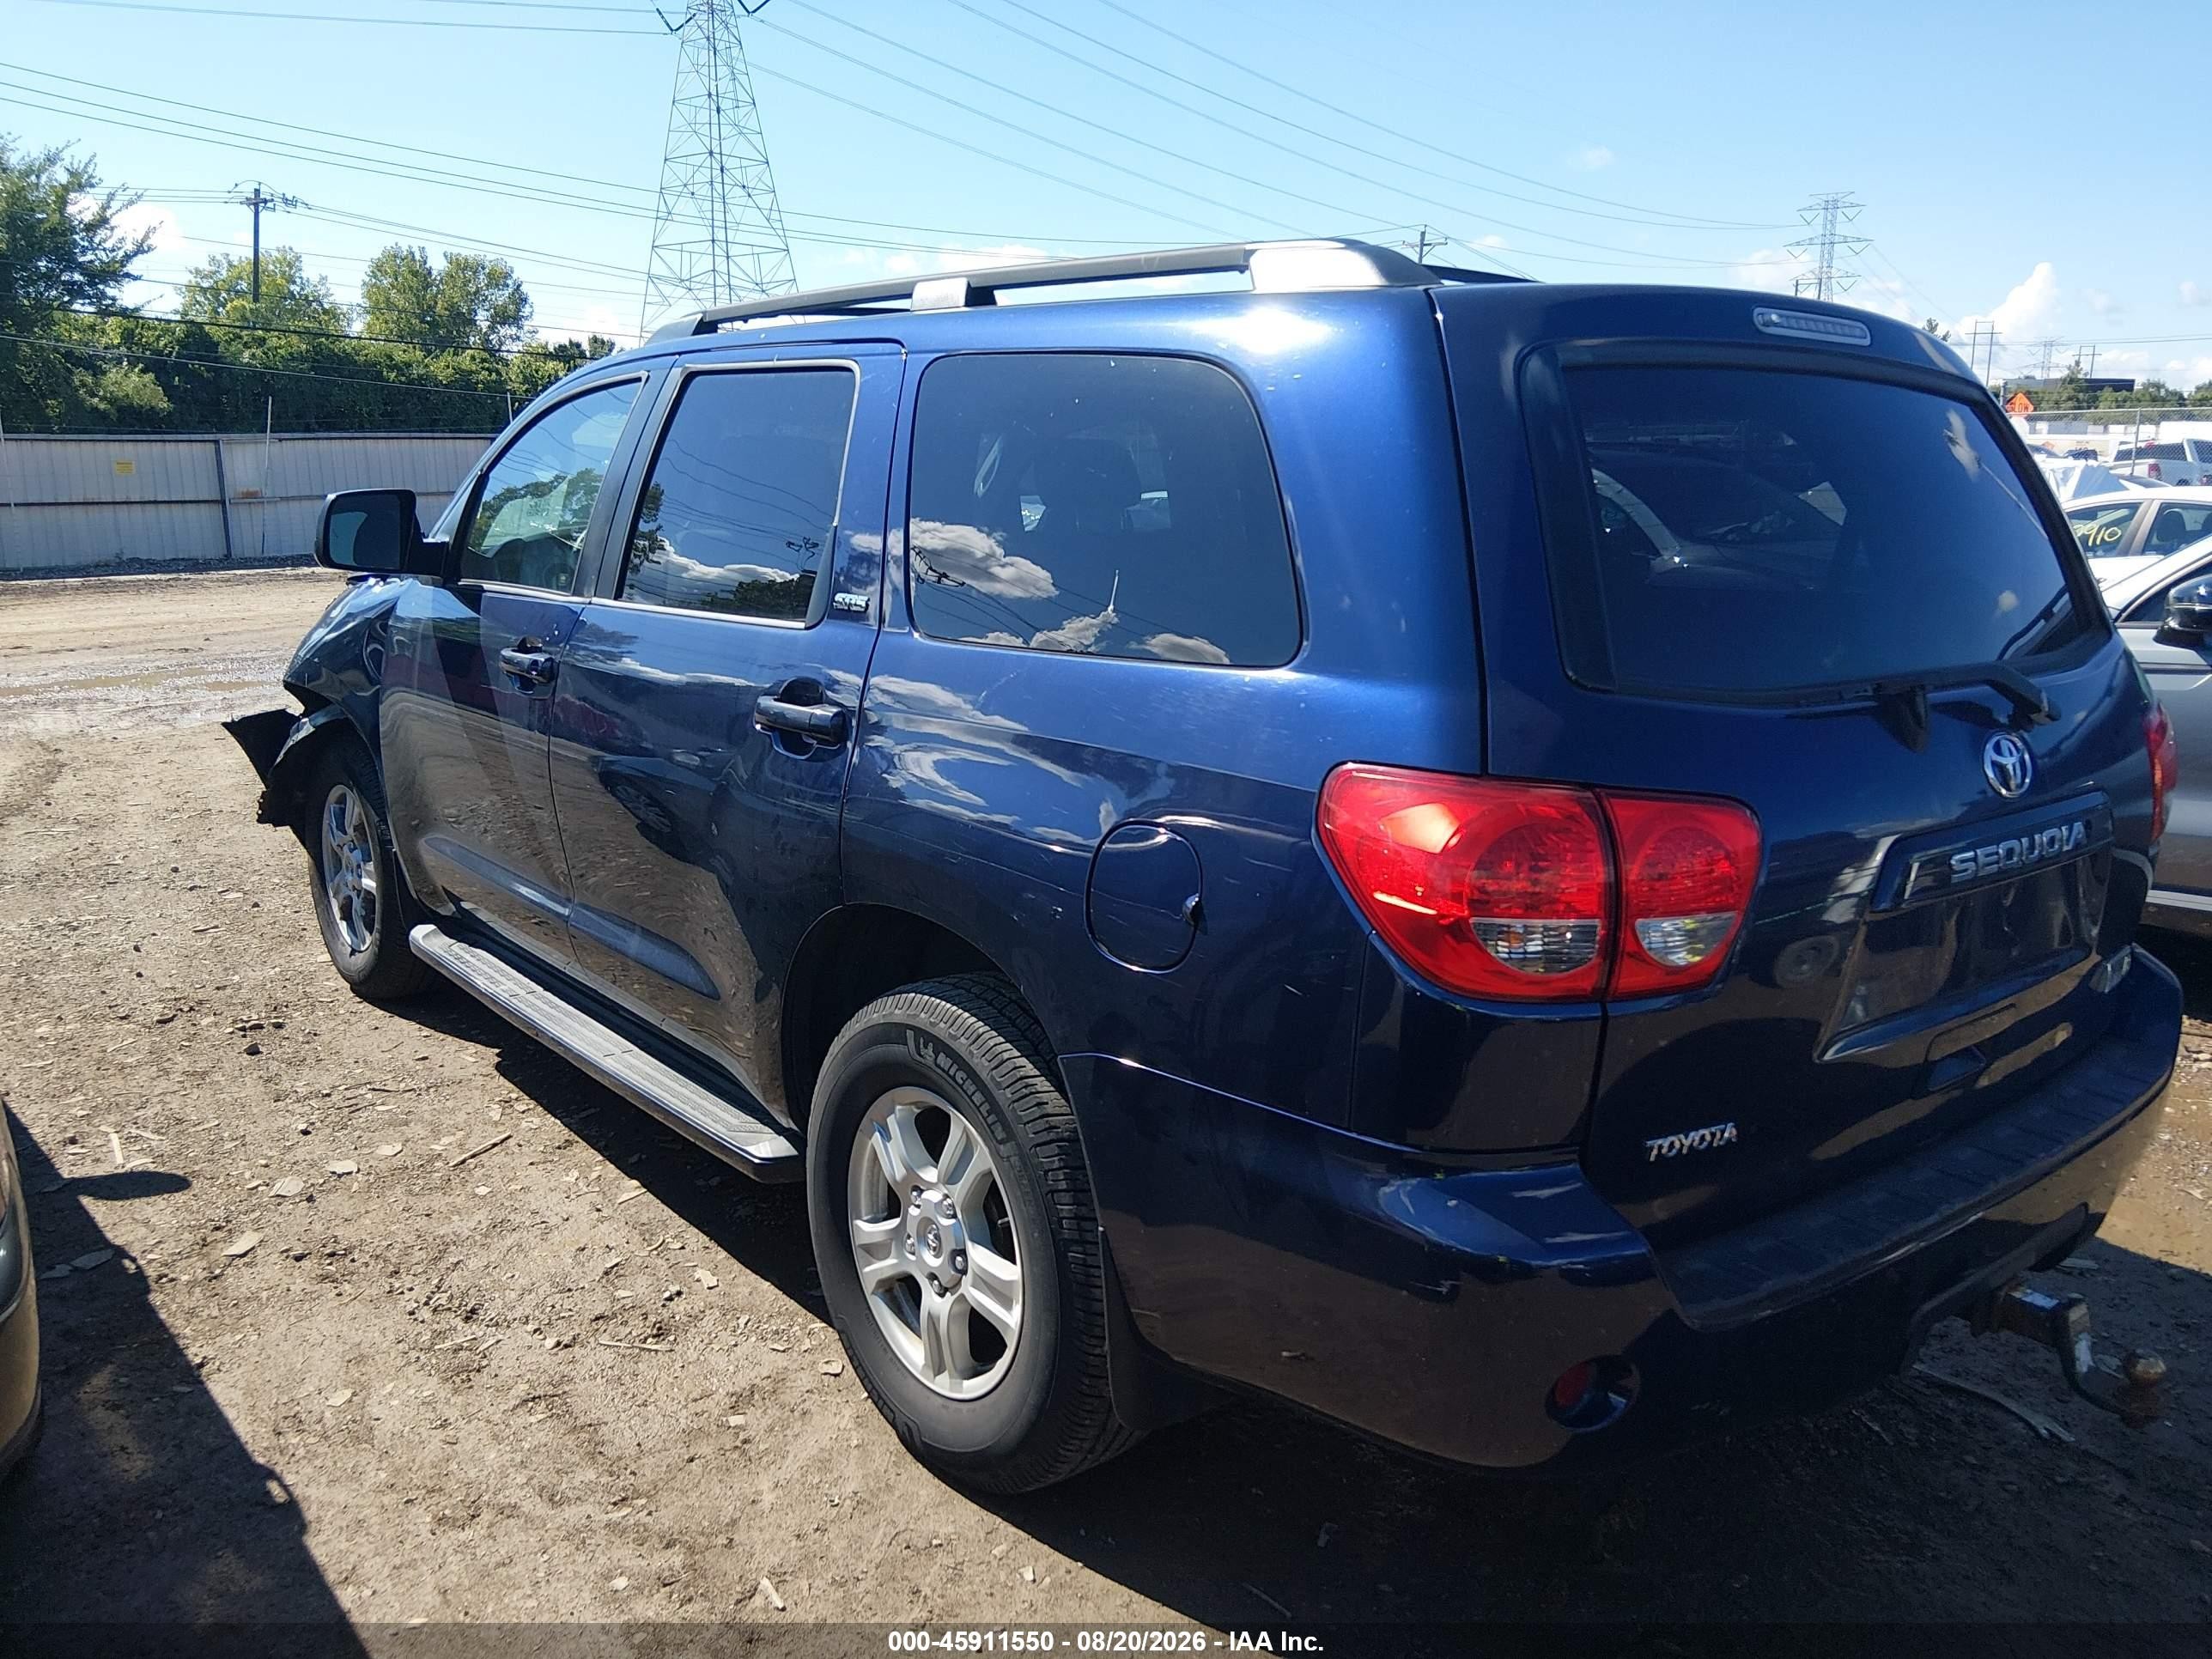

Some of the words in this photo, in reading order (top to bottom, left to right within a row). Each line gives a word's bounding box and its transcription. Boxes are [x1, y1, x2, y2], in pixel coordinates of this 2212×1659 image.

[1950, 821, 2087, 884] SEQUOIA
[936, 1051, 1008, 1142] MICHELIN
[1645, 1122, 1737, 1162] TOYOTA
